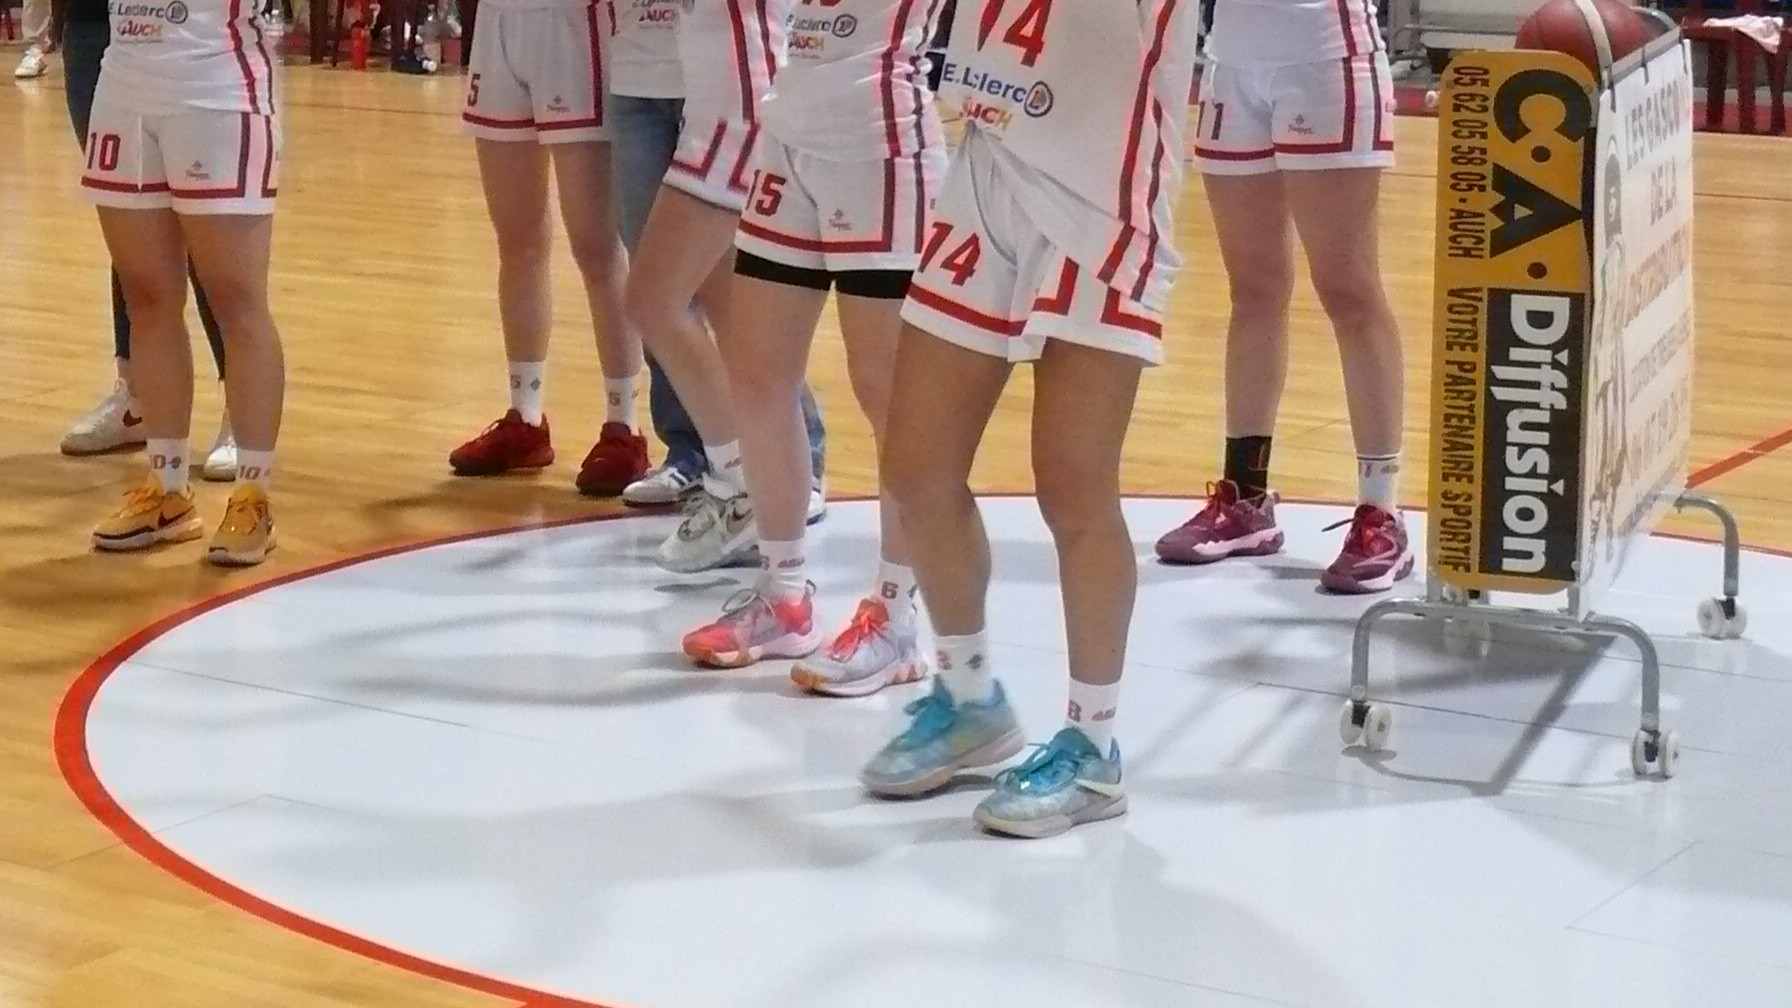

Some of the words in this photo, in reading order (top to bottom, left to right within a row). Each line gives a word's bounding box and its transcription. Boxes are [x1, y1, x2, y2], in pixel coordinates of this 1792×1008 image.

[1452, 65, 1491, 88] 05
[1451, 92, 1490, 114] 62
[86, 131, 121, 173] 10
[1450, 118, 1489, 140] 05
[1449, 144, 1488, 167] 58
[747, 166, 787, 217] 15
[1449, 171, 1487, 194] 05
[917, 220, 982, 287] 14
[1447, 207, 1486, 260] AUCH
[1444, 286, 1484, 353] VOTRE
[1440, 358, 1478, 485] PARTENAIRE
[1489, 293, 1571, 574] Diffusion
[1437, 488, 1474, 575] SPORTIF
